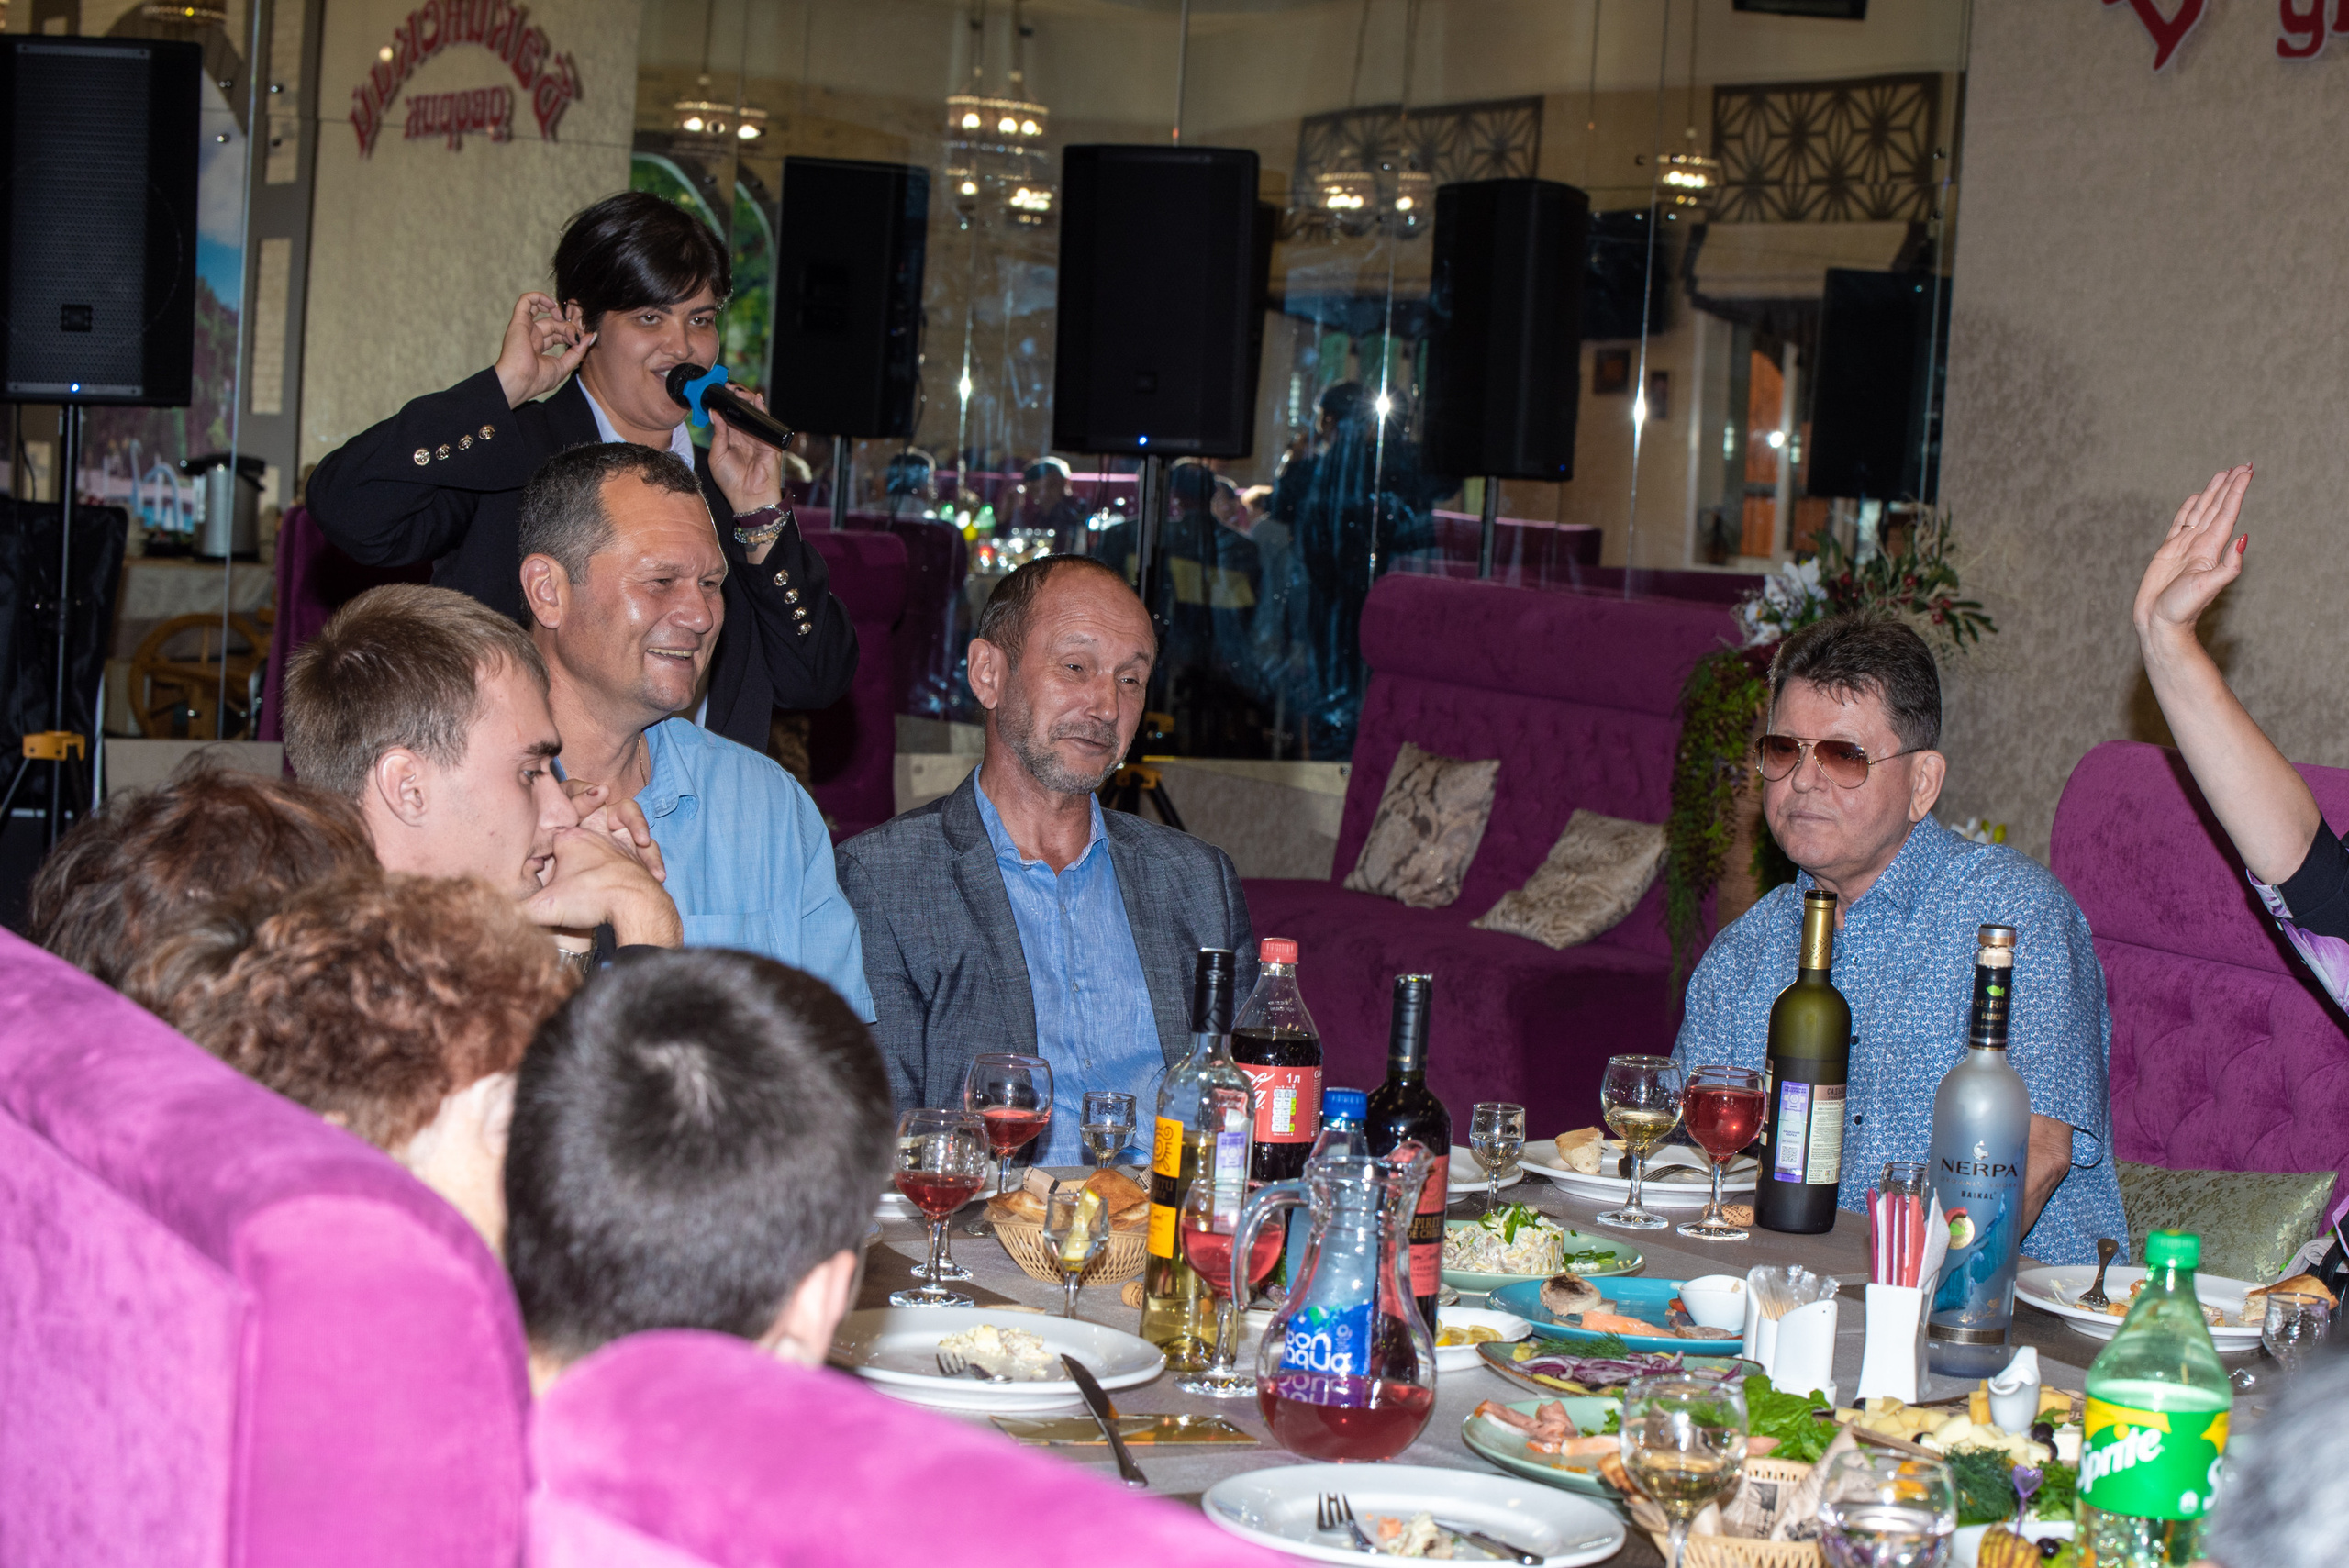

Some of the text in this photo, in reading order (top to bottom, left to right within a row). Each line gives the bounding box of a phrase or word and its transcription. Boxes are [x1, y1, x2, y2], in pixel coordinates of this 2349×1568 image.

[1941, 1157, 2018, 1177] NERPA
[1940, 1175, 1983, 1188] ORGANIC
[1961, 1190, 1994, 1200] BAIKAL
